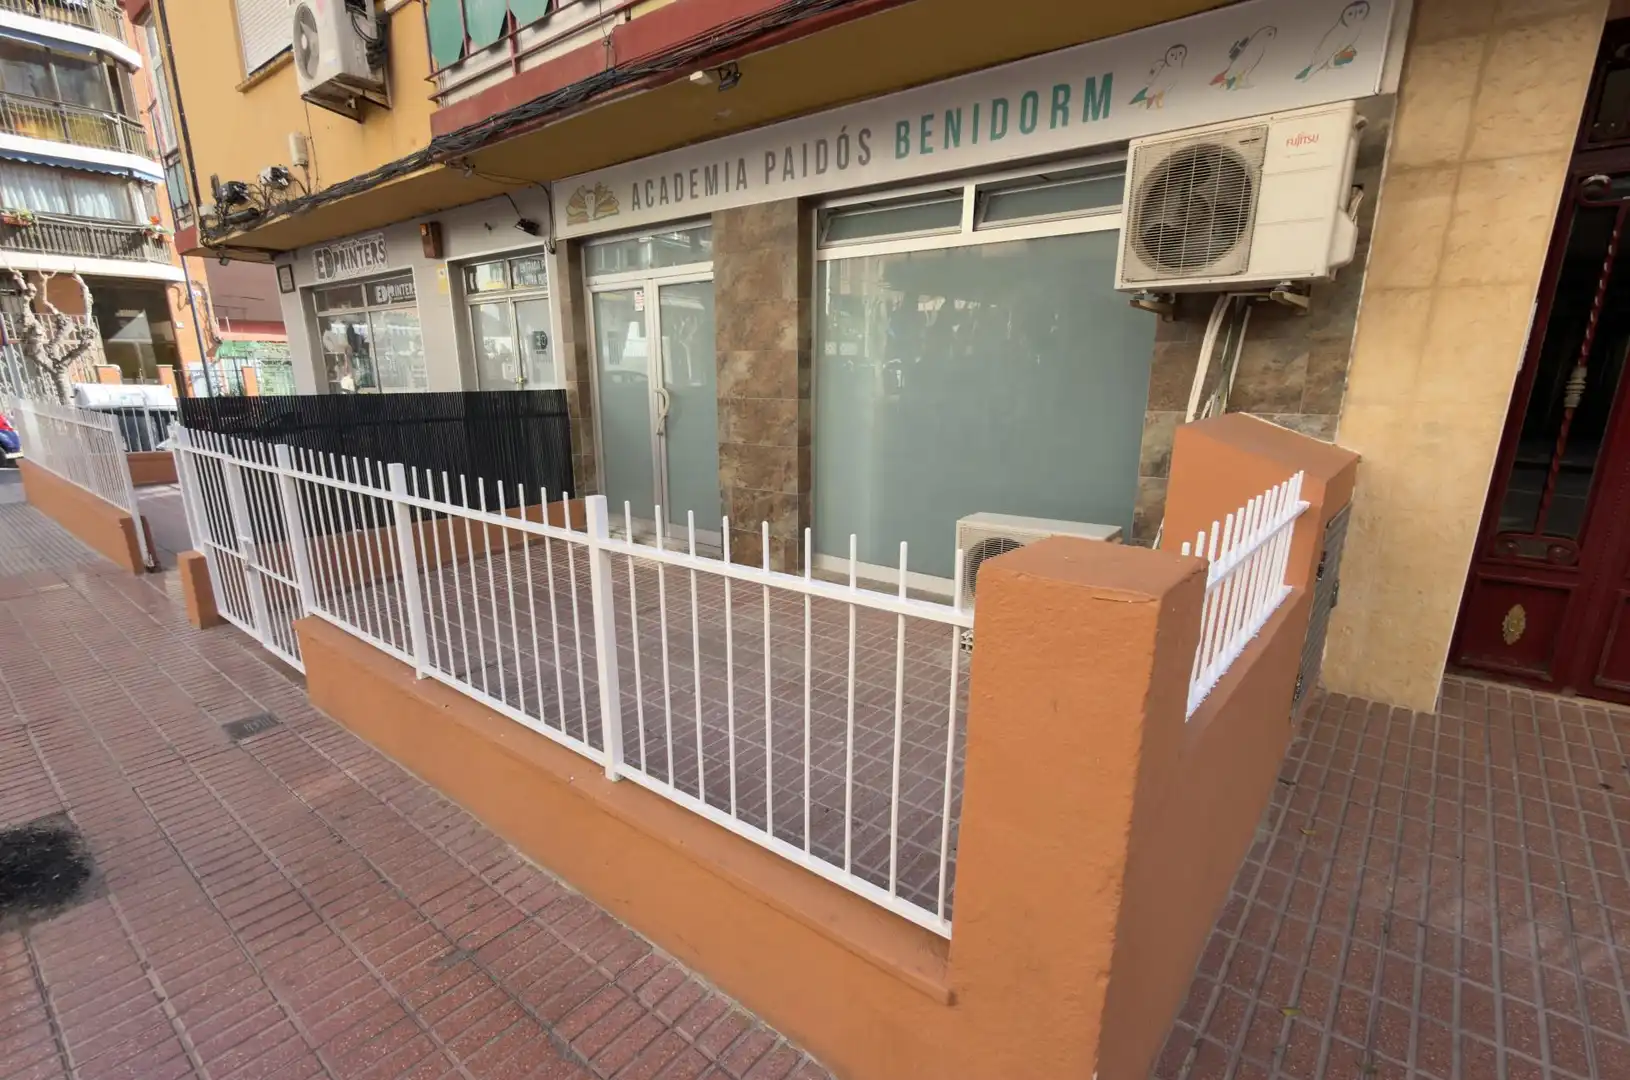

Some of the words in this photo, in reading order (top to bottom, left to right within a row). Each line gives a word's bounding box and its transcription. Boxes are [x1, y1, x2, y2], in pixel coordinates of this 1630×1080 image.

[631, 157, 748, 211] ACADEMIA
[764, 125, 872, 185] PAIDÓS
[895, 72, 1114, 160] BENIDORM
[1286, 132, 1319, 148] FUJITSU
